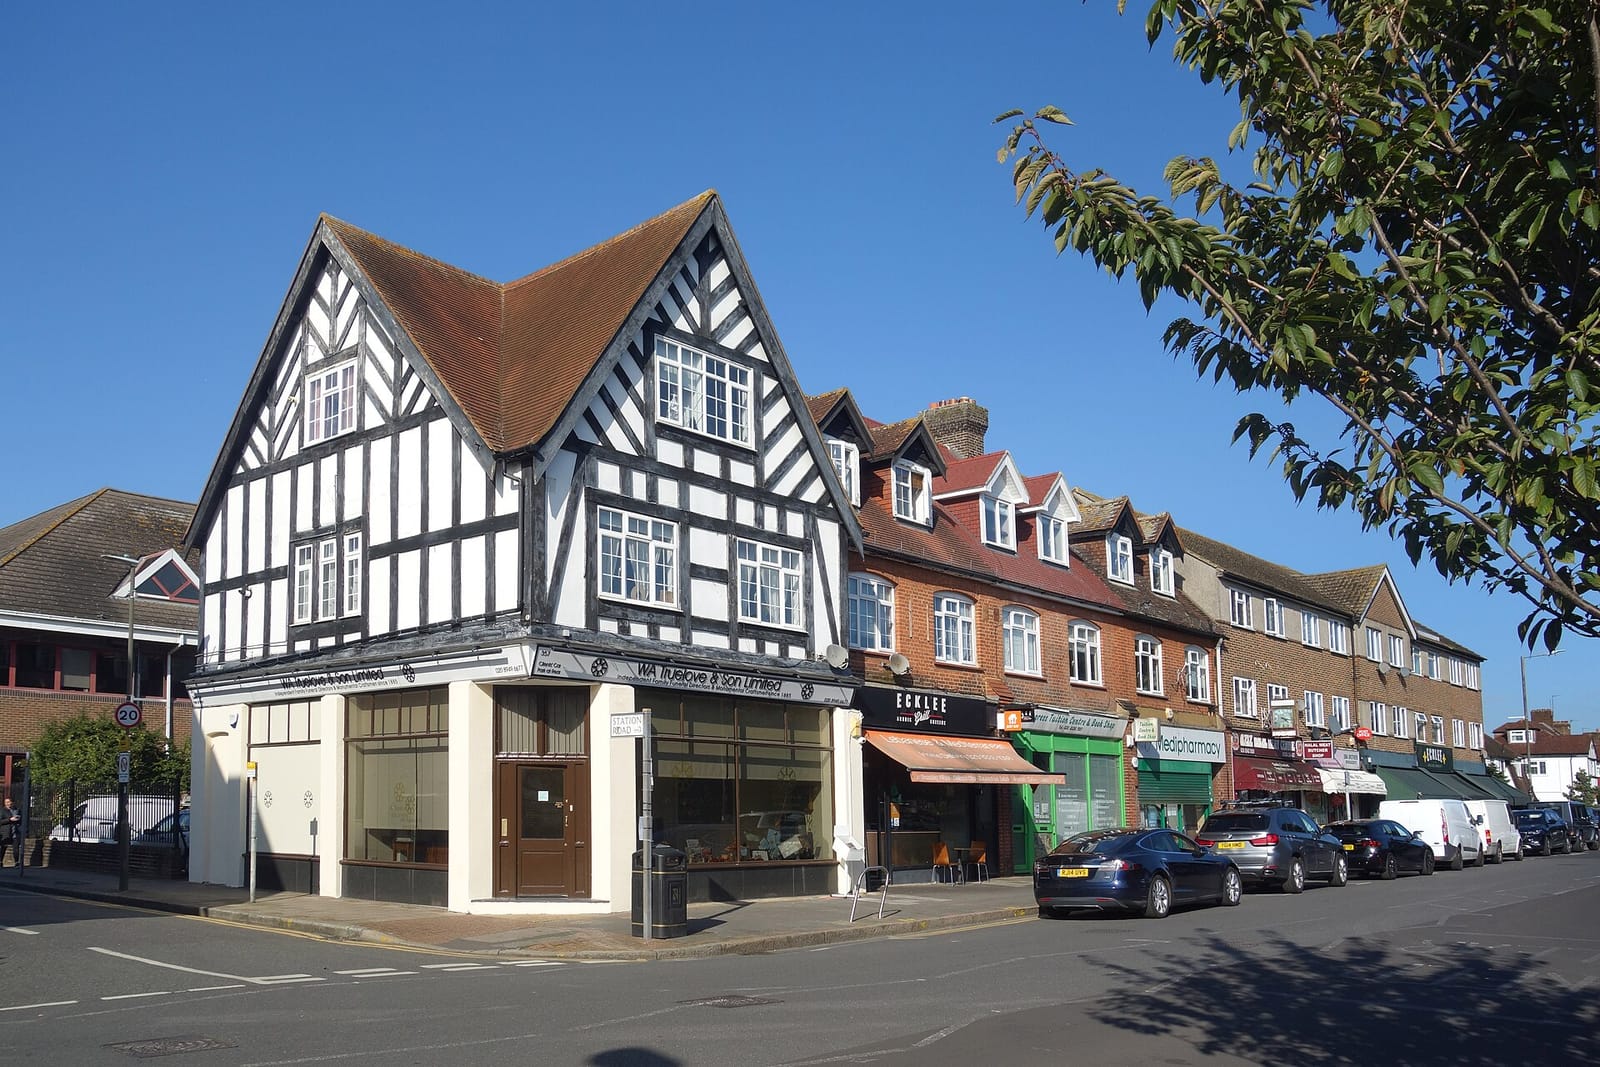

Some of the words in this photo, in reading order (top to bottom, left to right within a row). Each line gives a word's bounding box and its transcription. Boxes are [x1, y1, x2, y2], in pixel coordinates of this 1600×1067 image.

[351, 668, 384, 683] Limited
[660, 664, 707, 683] Truelove
[710, 670, 720, 684] &
[721, 673, 741, 688] Son
[744, 676, 782, 692] Limited
[896, 692, 946, 713] ECKLEE
[120, 710, 138, 720] 20
[612, 716, 642, 726] STATION
[1050, 712, 1069, 724] Tuition
[1103, 720, 1116, 730] Shop
[612, 726, 632, 735] ROAD
[1156, 736, 1220, 758] Medipharmacy
